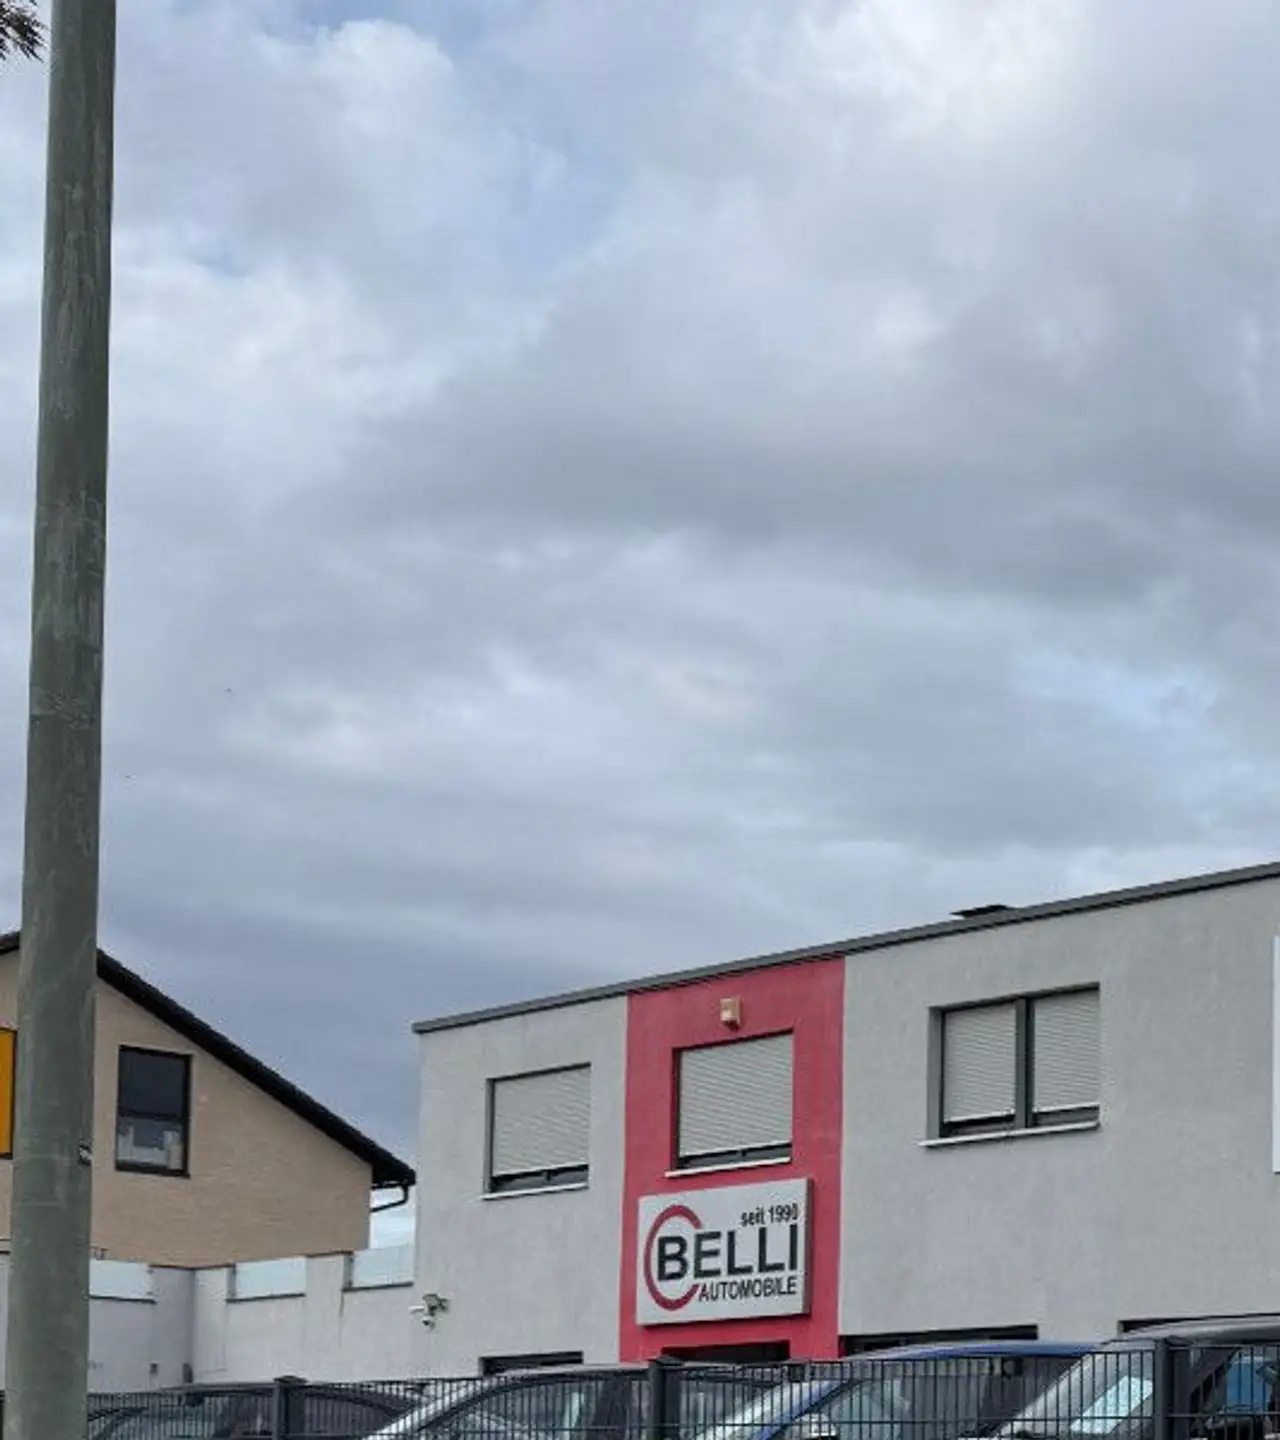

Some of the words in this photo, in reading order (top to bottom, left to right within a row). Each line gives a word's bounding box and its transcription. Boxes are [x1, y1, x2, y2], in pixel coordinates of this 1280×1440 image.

[741, 1207, 765, 1227] seit
[657, 1223, 799, 1282] BELLI
[698, 1275, 798, 1302] AUTOMOBILE
